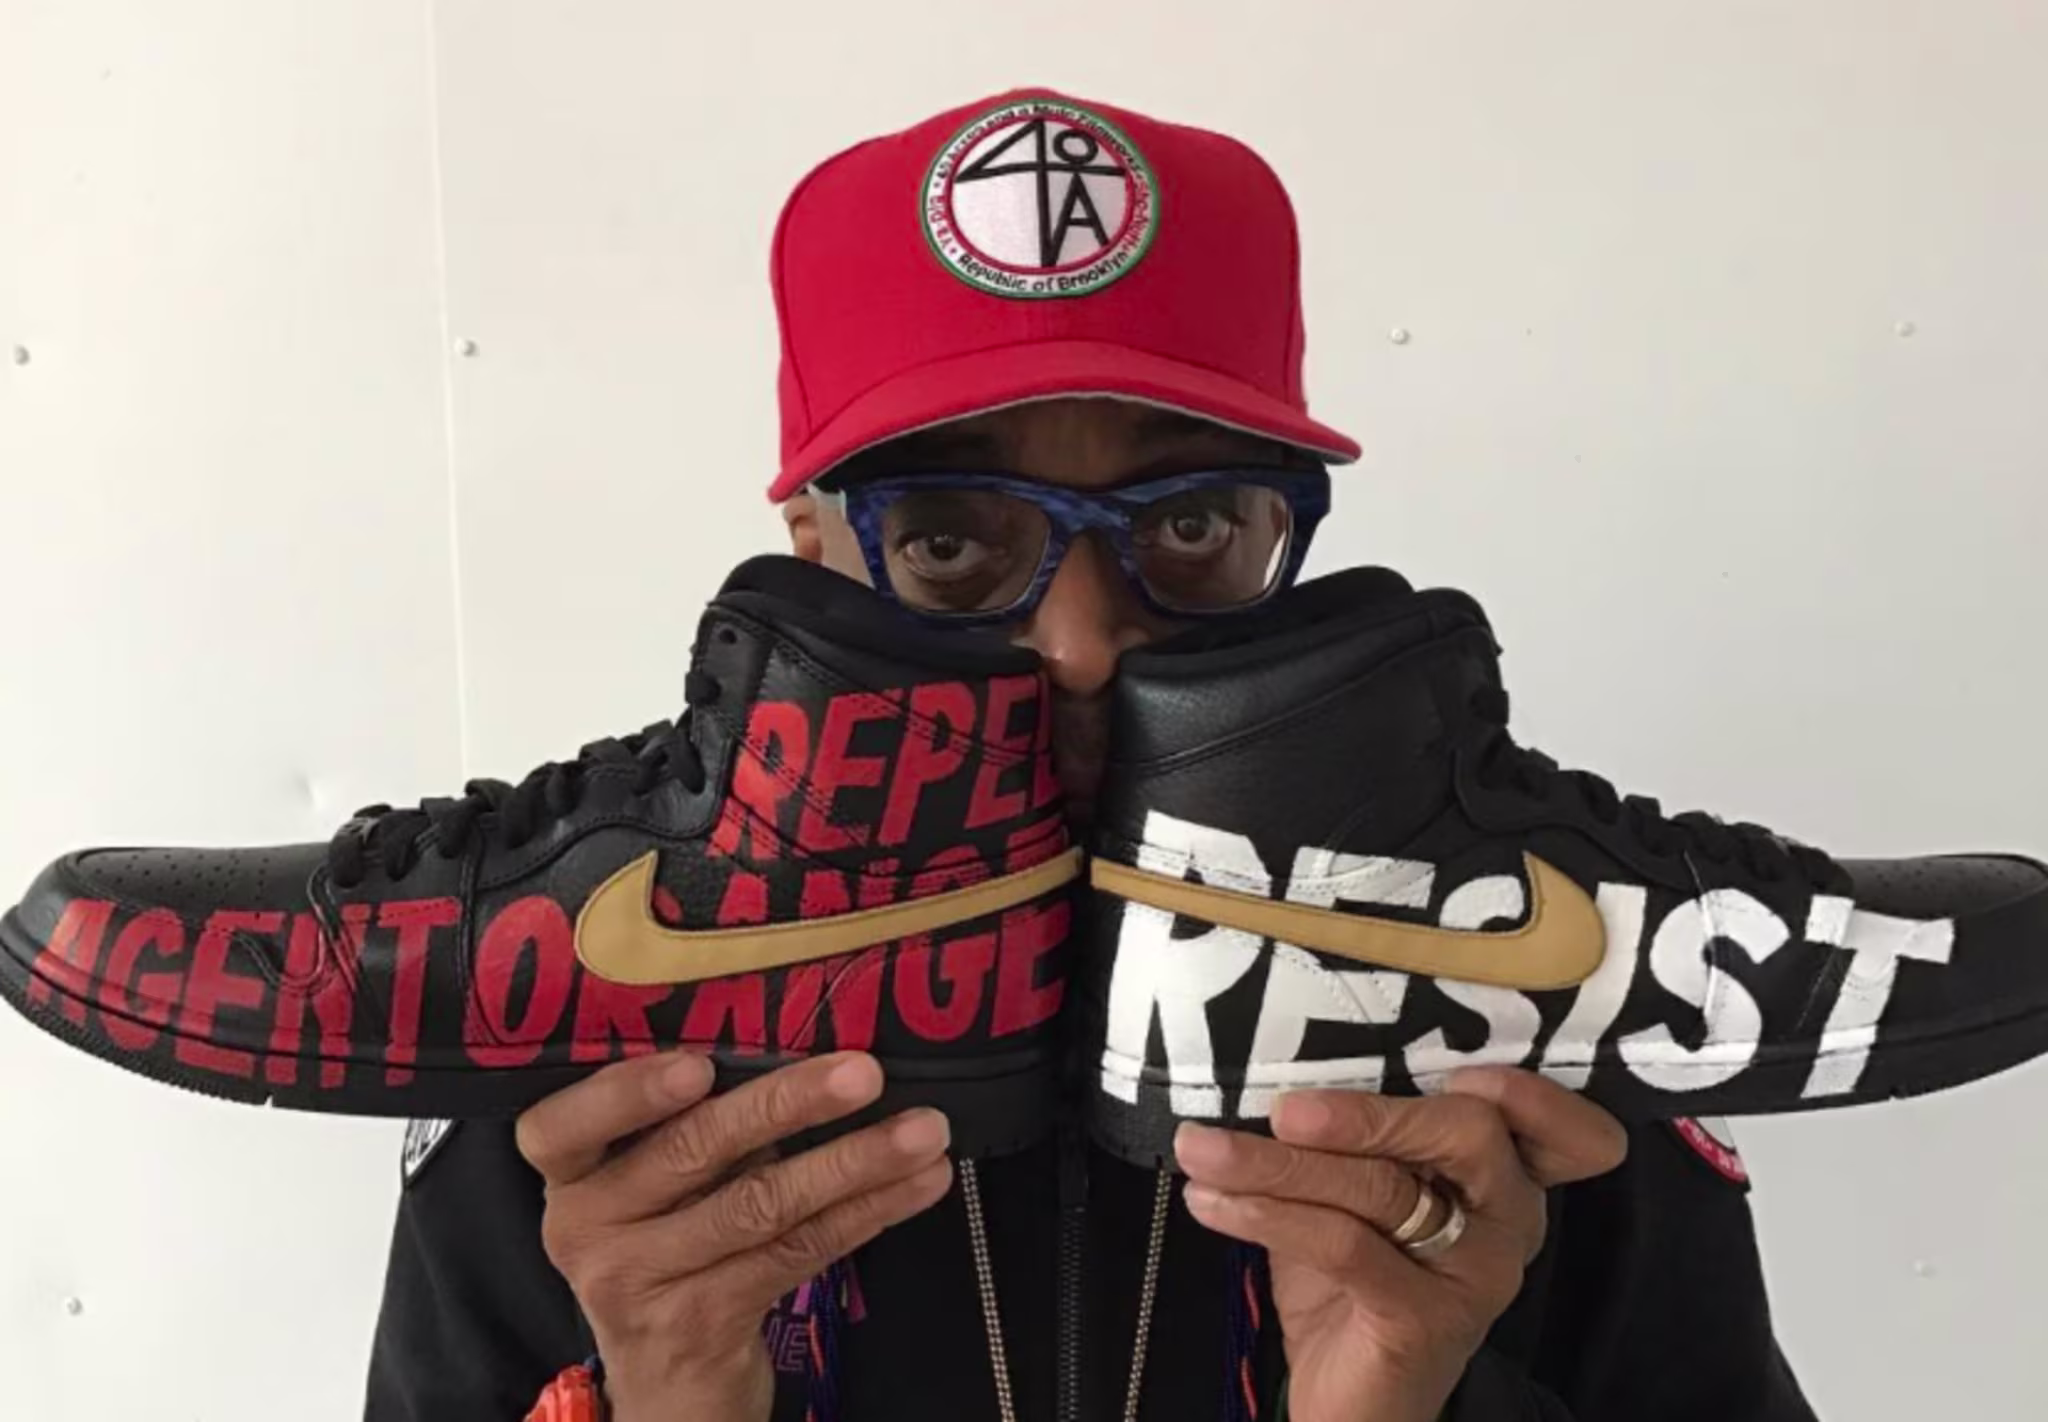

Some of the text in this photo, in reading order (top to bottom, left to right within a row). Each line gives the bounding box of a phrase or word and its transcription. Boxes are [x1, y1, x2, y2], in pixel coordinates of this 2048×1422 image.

[957, 249, 1129, 292] Republic of Brooklyn
[25, 896, 461, 1090] AGENT
[1099, 808, 1955, 1119] RESIST
